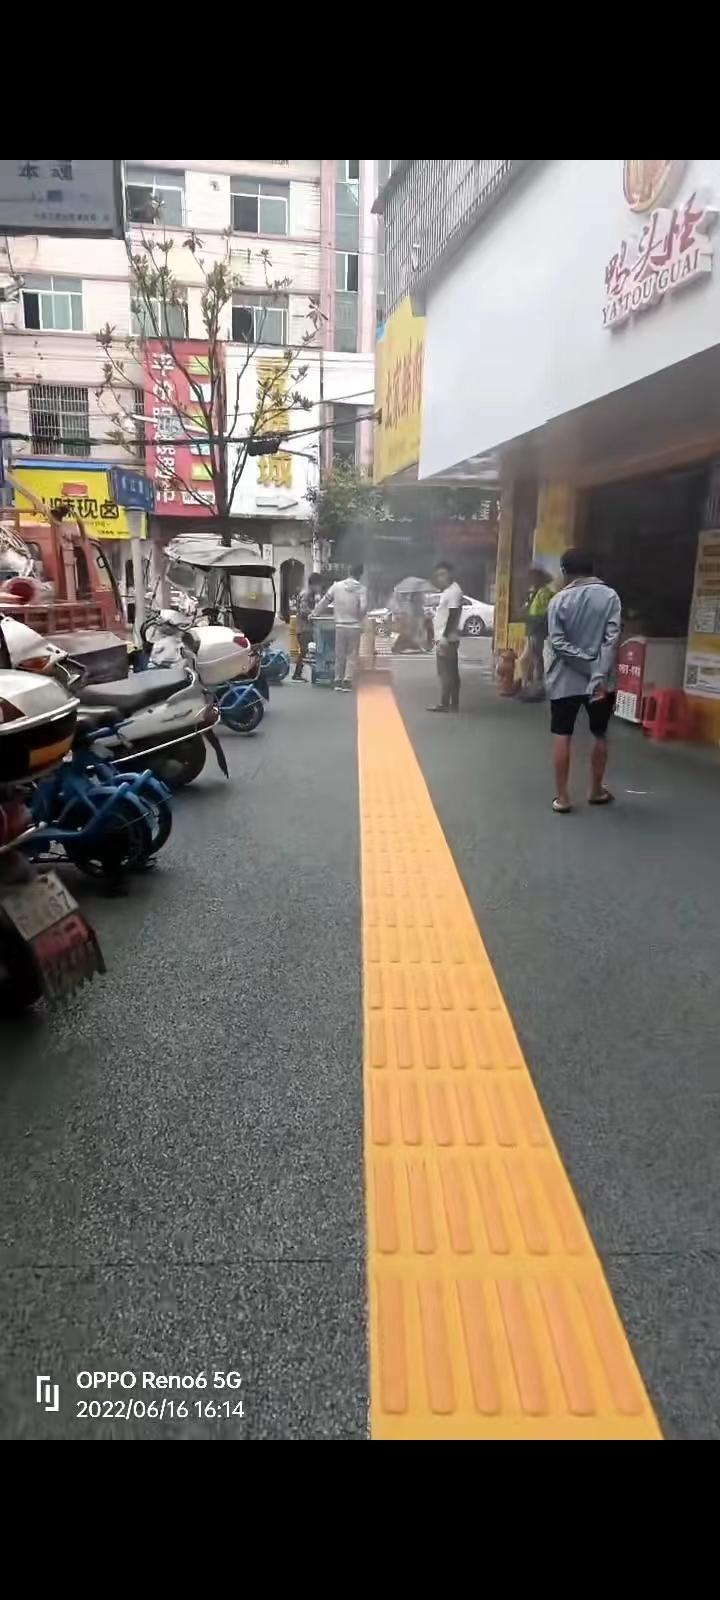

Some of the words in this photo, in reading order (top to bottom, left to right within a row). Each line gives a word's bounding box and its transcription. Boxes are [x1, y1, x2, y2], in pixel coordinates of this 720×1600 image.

[624, 279, 653, 312] TOU
[658, 248, 700, 290] GUAI
[33, 496, 119, 519] 味现卤
